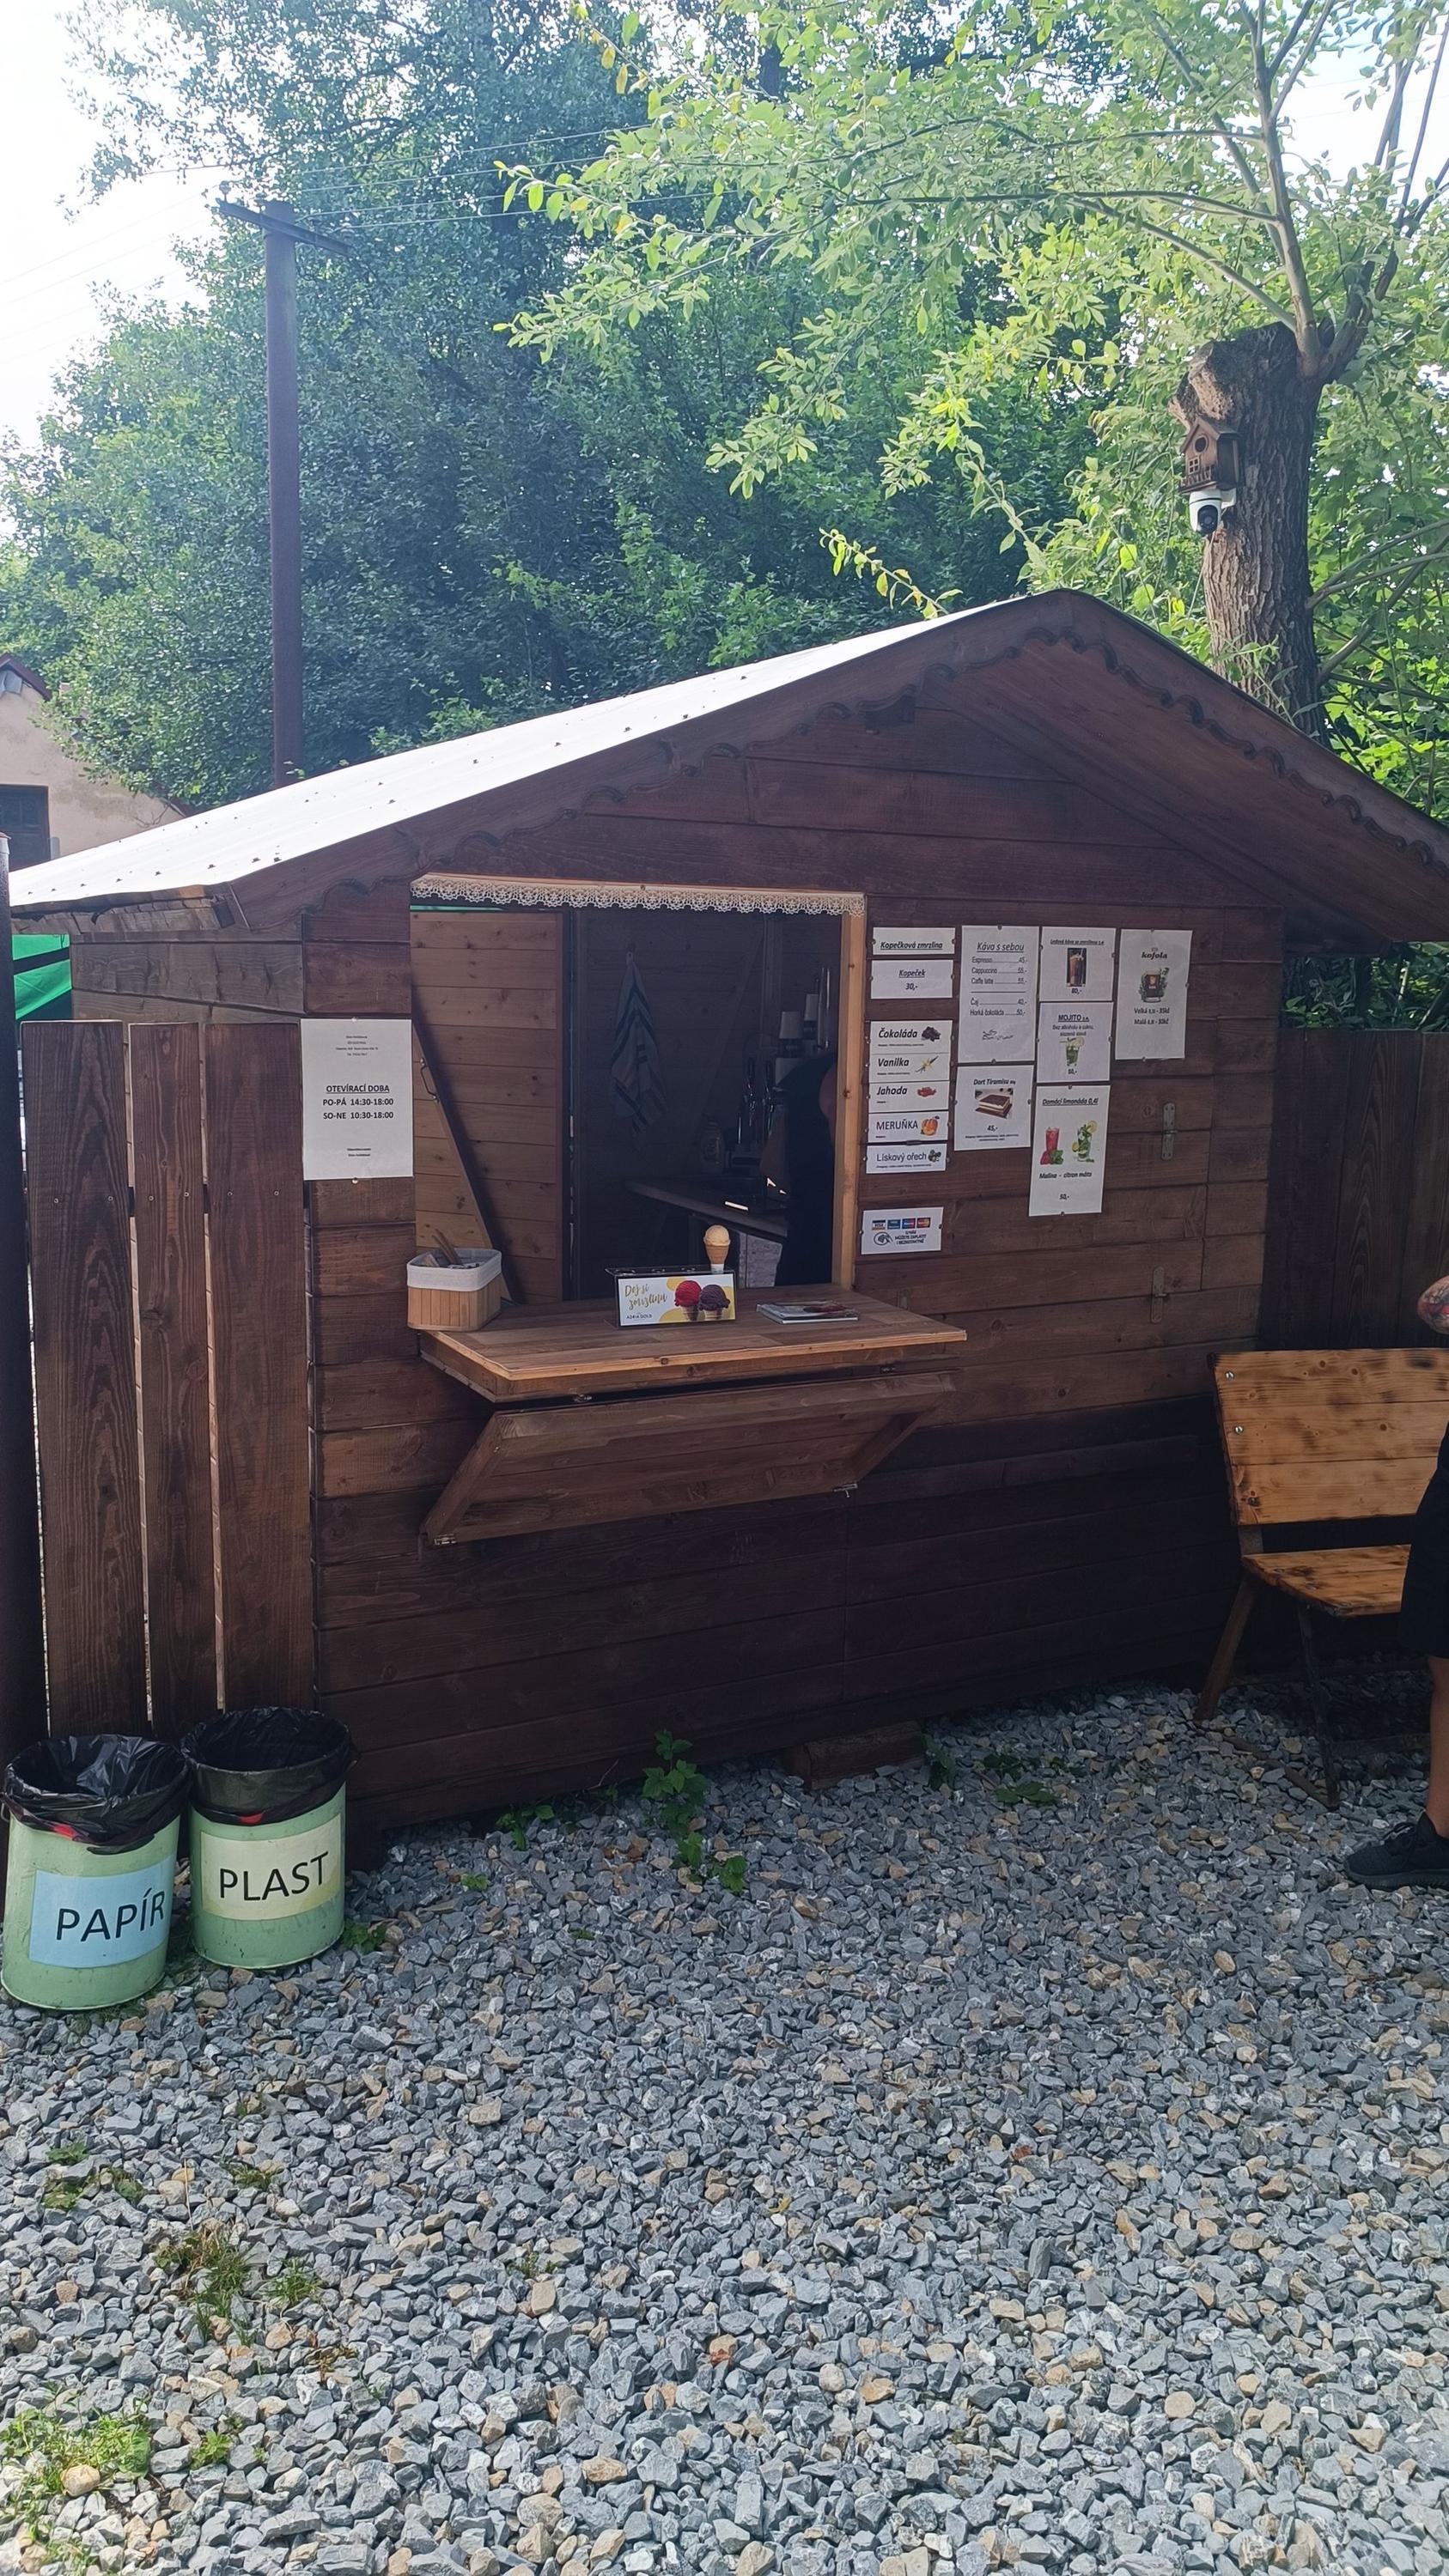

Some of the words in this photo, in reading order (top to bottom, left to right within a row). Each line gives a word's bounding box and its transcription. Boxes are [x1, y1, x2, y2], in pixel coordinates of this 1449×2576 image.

[880, 941, 916, 950] Kopečková
[977, 942, 995, 951] Káva
[1142, 951, 1167, 960] kofola
[879, 1027, 917, 1038] Čokoláda
[878, 1058, 910, 1066] Vanilka
[326, 1084, 367, 1092] OTEVÍRACÍ
[876, 1086, 907, 1095] Jahoda
[323, 1097, 347, 1106] PO-PÁ
[350, 1111, 393, 1120] 10:30-18:00
[876, 1119, 918, 1130] MERUŇKA
[876, 1152, 905, 1163] Lískový
[906, 1151, 927, 1160] ořech
[219, 1851, 330, 1901] PLAST
[56, 1887, 165, 1942] PAPÍR
